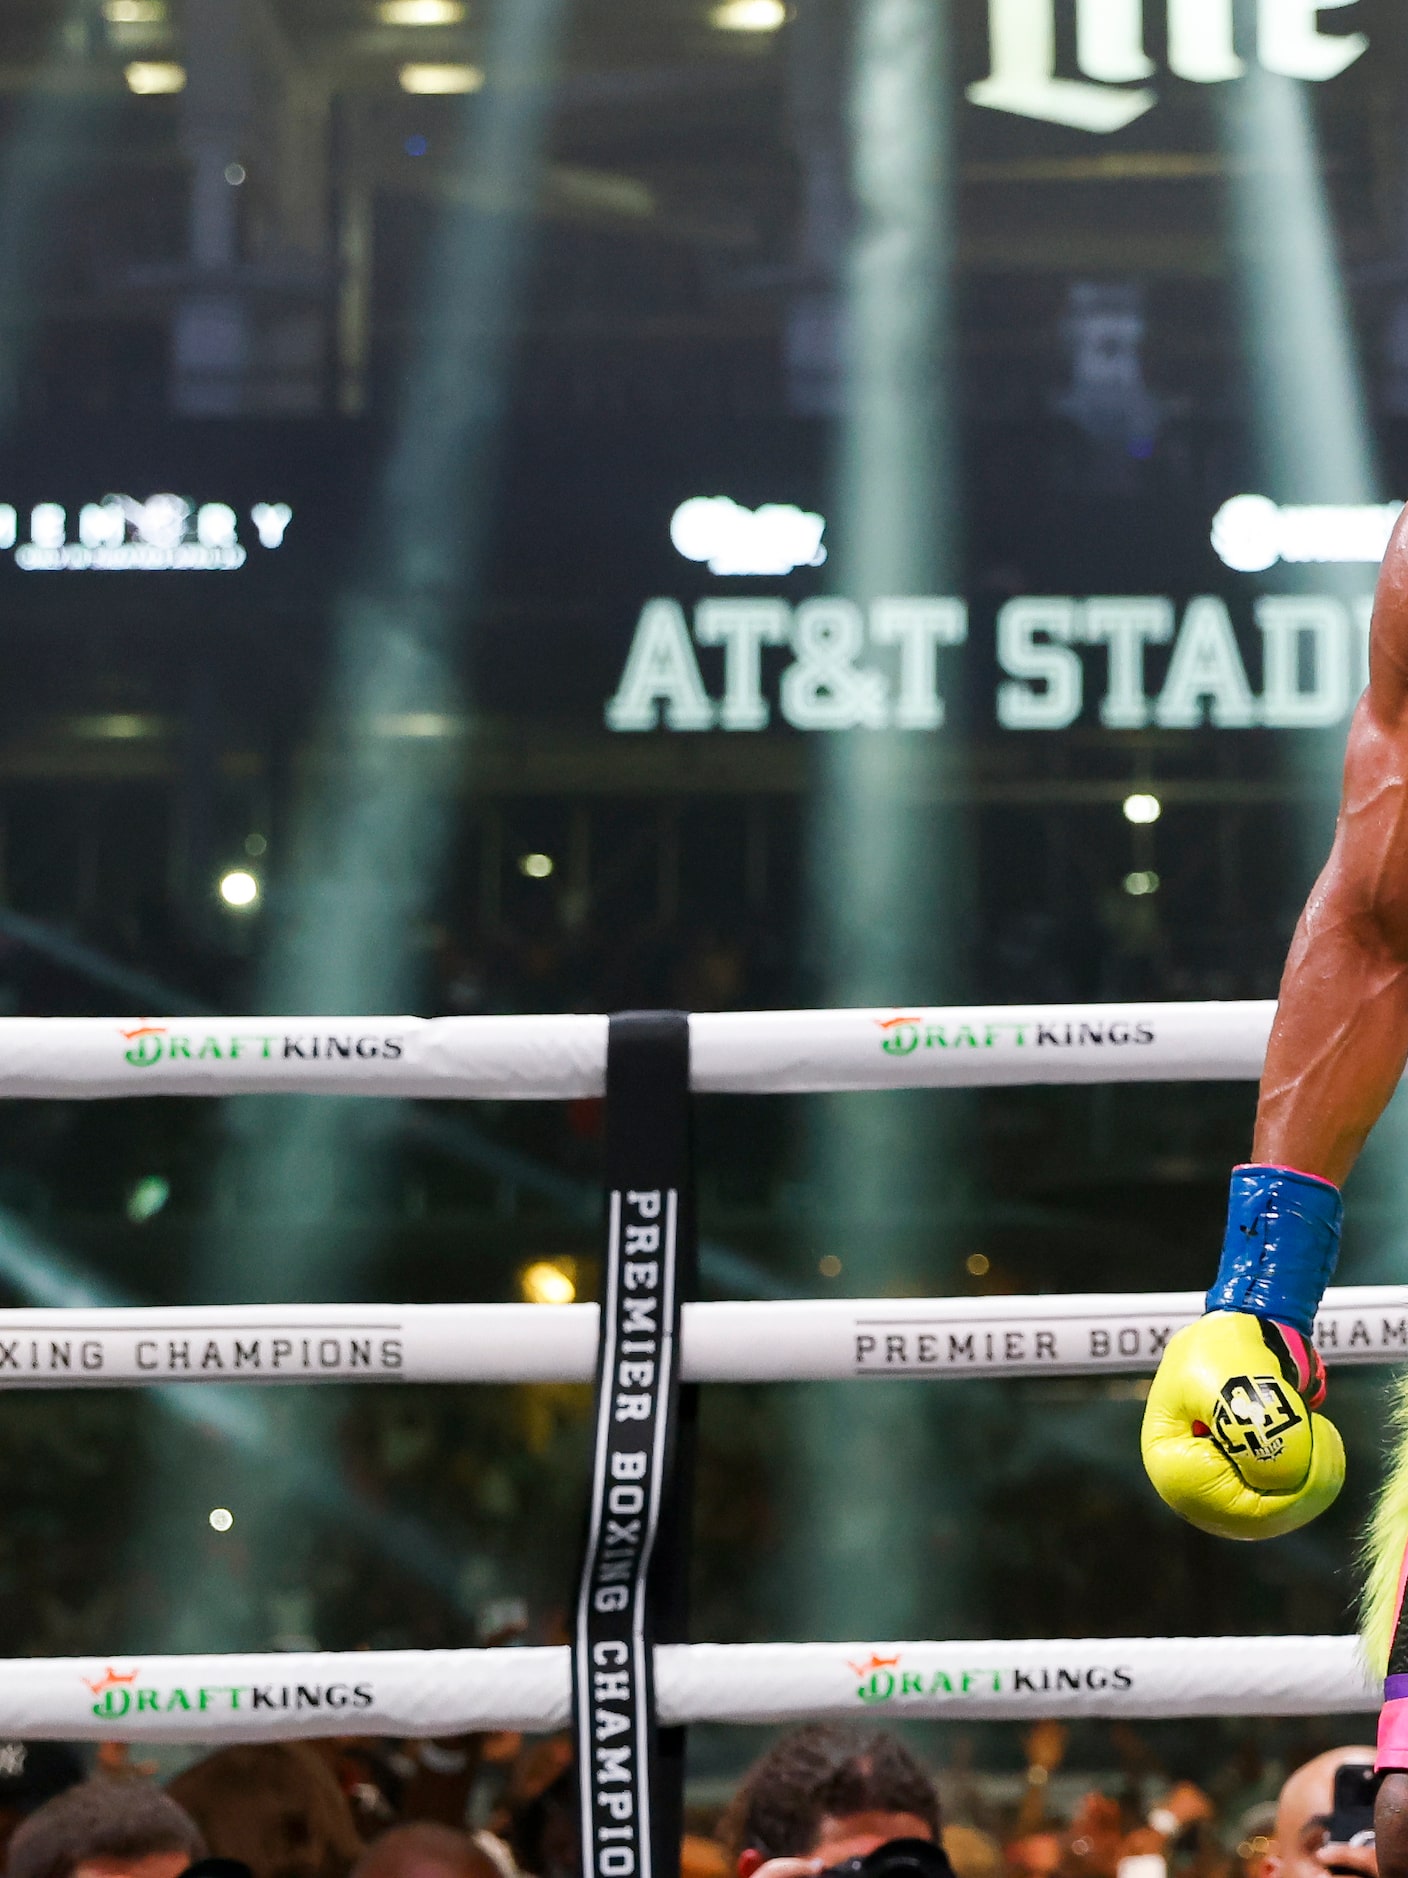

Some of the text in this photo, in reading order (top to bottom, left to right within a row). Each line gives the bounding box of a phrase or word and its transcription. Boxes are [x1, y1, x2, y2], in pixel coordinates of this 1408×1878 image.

[604, 595, 968, 733] AT&T
[125, 1030, 404, 1067] DRAFTKINGS
[881, 1021, 1156, 1056] DRAFTKINGS
[615, 1189, 662, 1422] PREMIER
[134, 1338, 404, 1371] CHAMPIONS
[857, 1331, 1058, 1363] PREMIER
[1090, 1327, 1170, 1360] BOX
[594, 1450, 648, 1613] BOXING
[93, 1683, 374, 1720] DRAFTKINGS
[856, 1665, 1134, 1704] DRAFTKINGS
